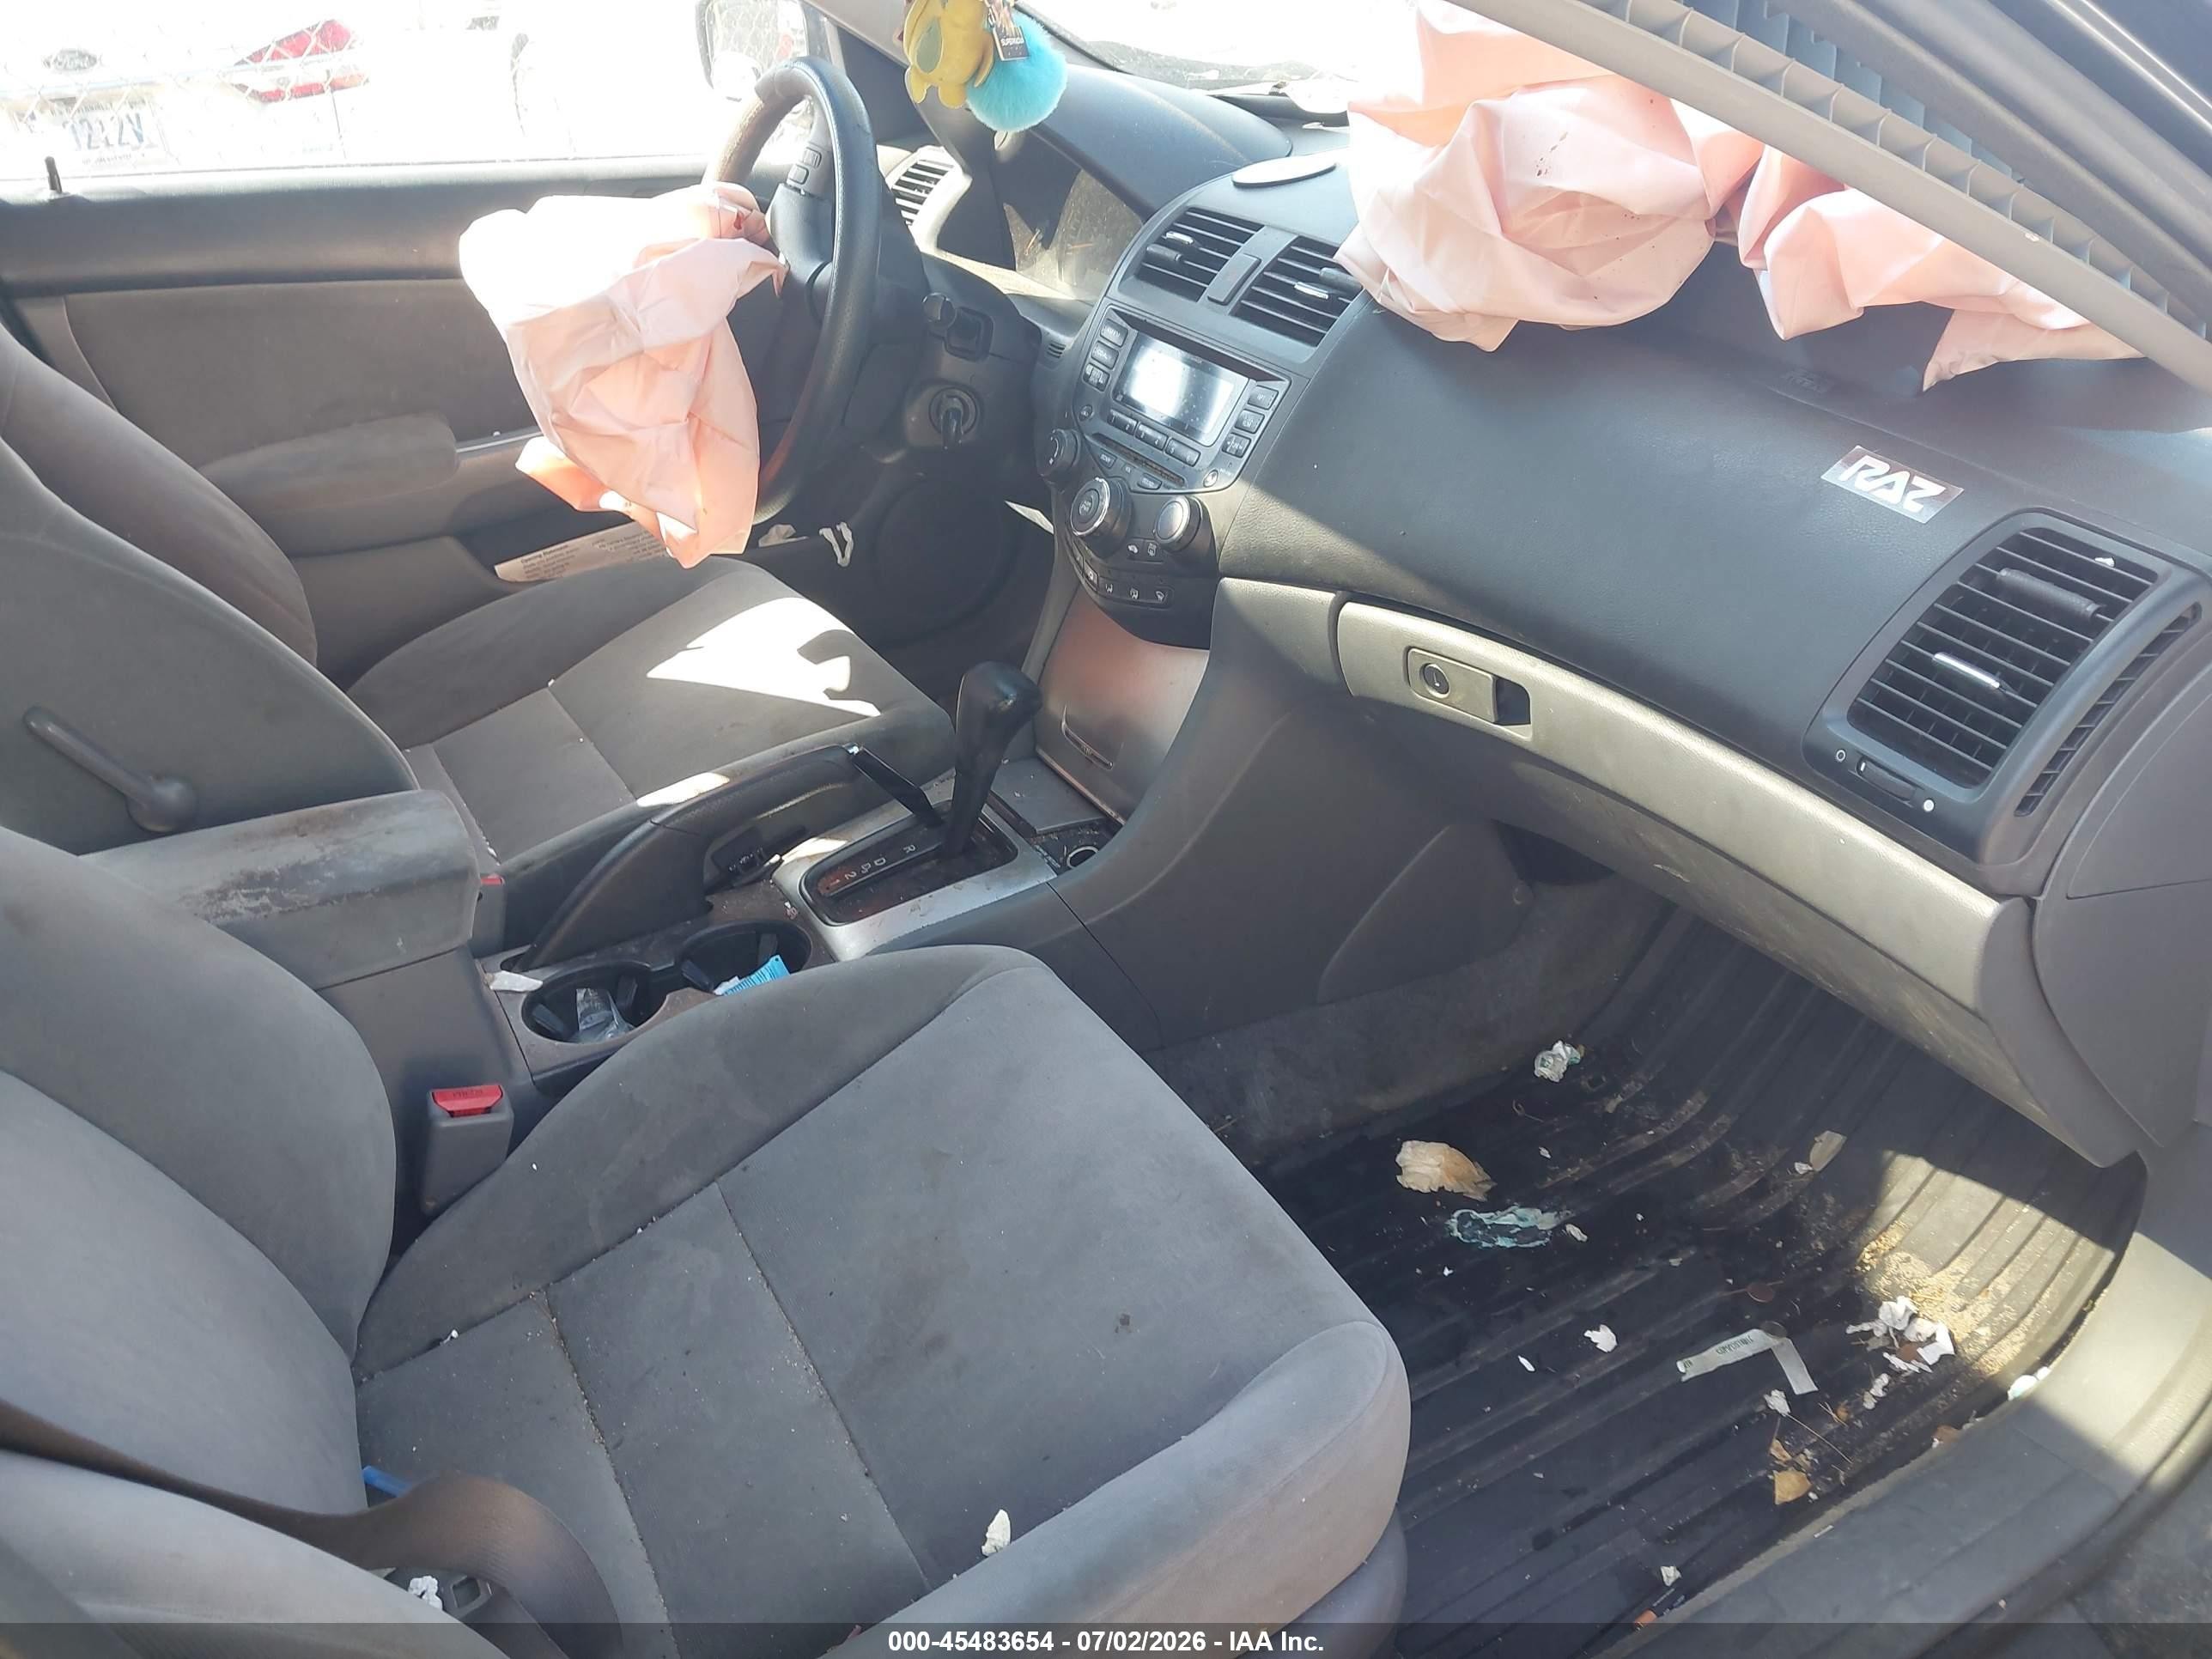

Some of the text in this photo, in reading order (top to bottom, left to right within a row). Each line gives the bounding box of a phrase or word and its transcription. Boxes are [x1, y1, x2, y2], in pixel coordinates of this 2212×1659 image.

[1838, 455, 1946, 513] RAZ
[903, 844, 916, 854] R
[874, 857, 886, 866] D
[844, 871, 857, 880] 2
